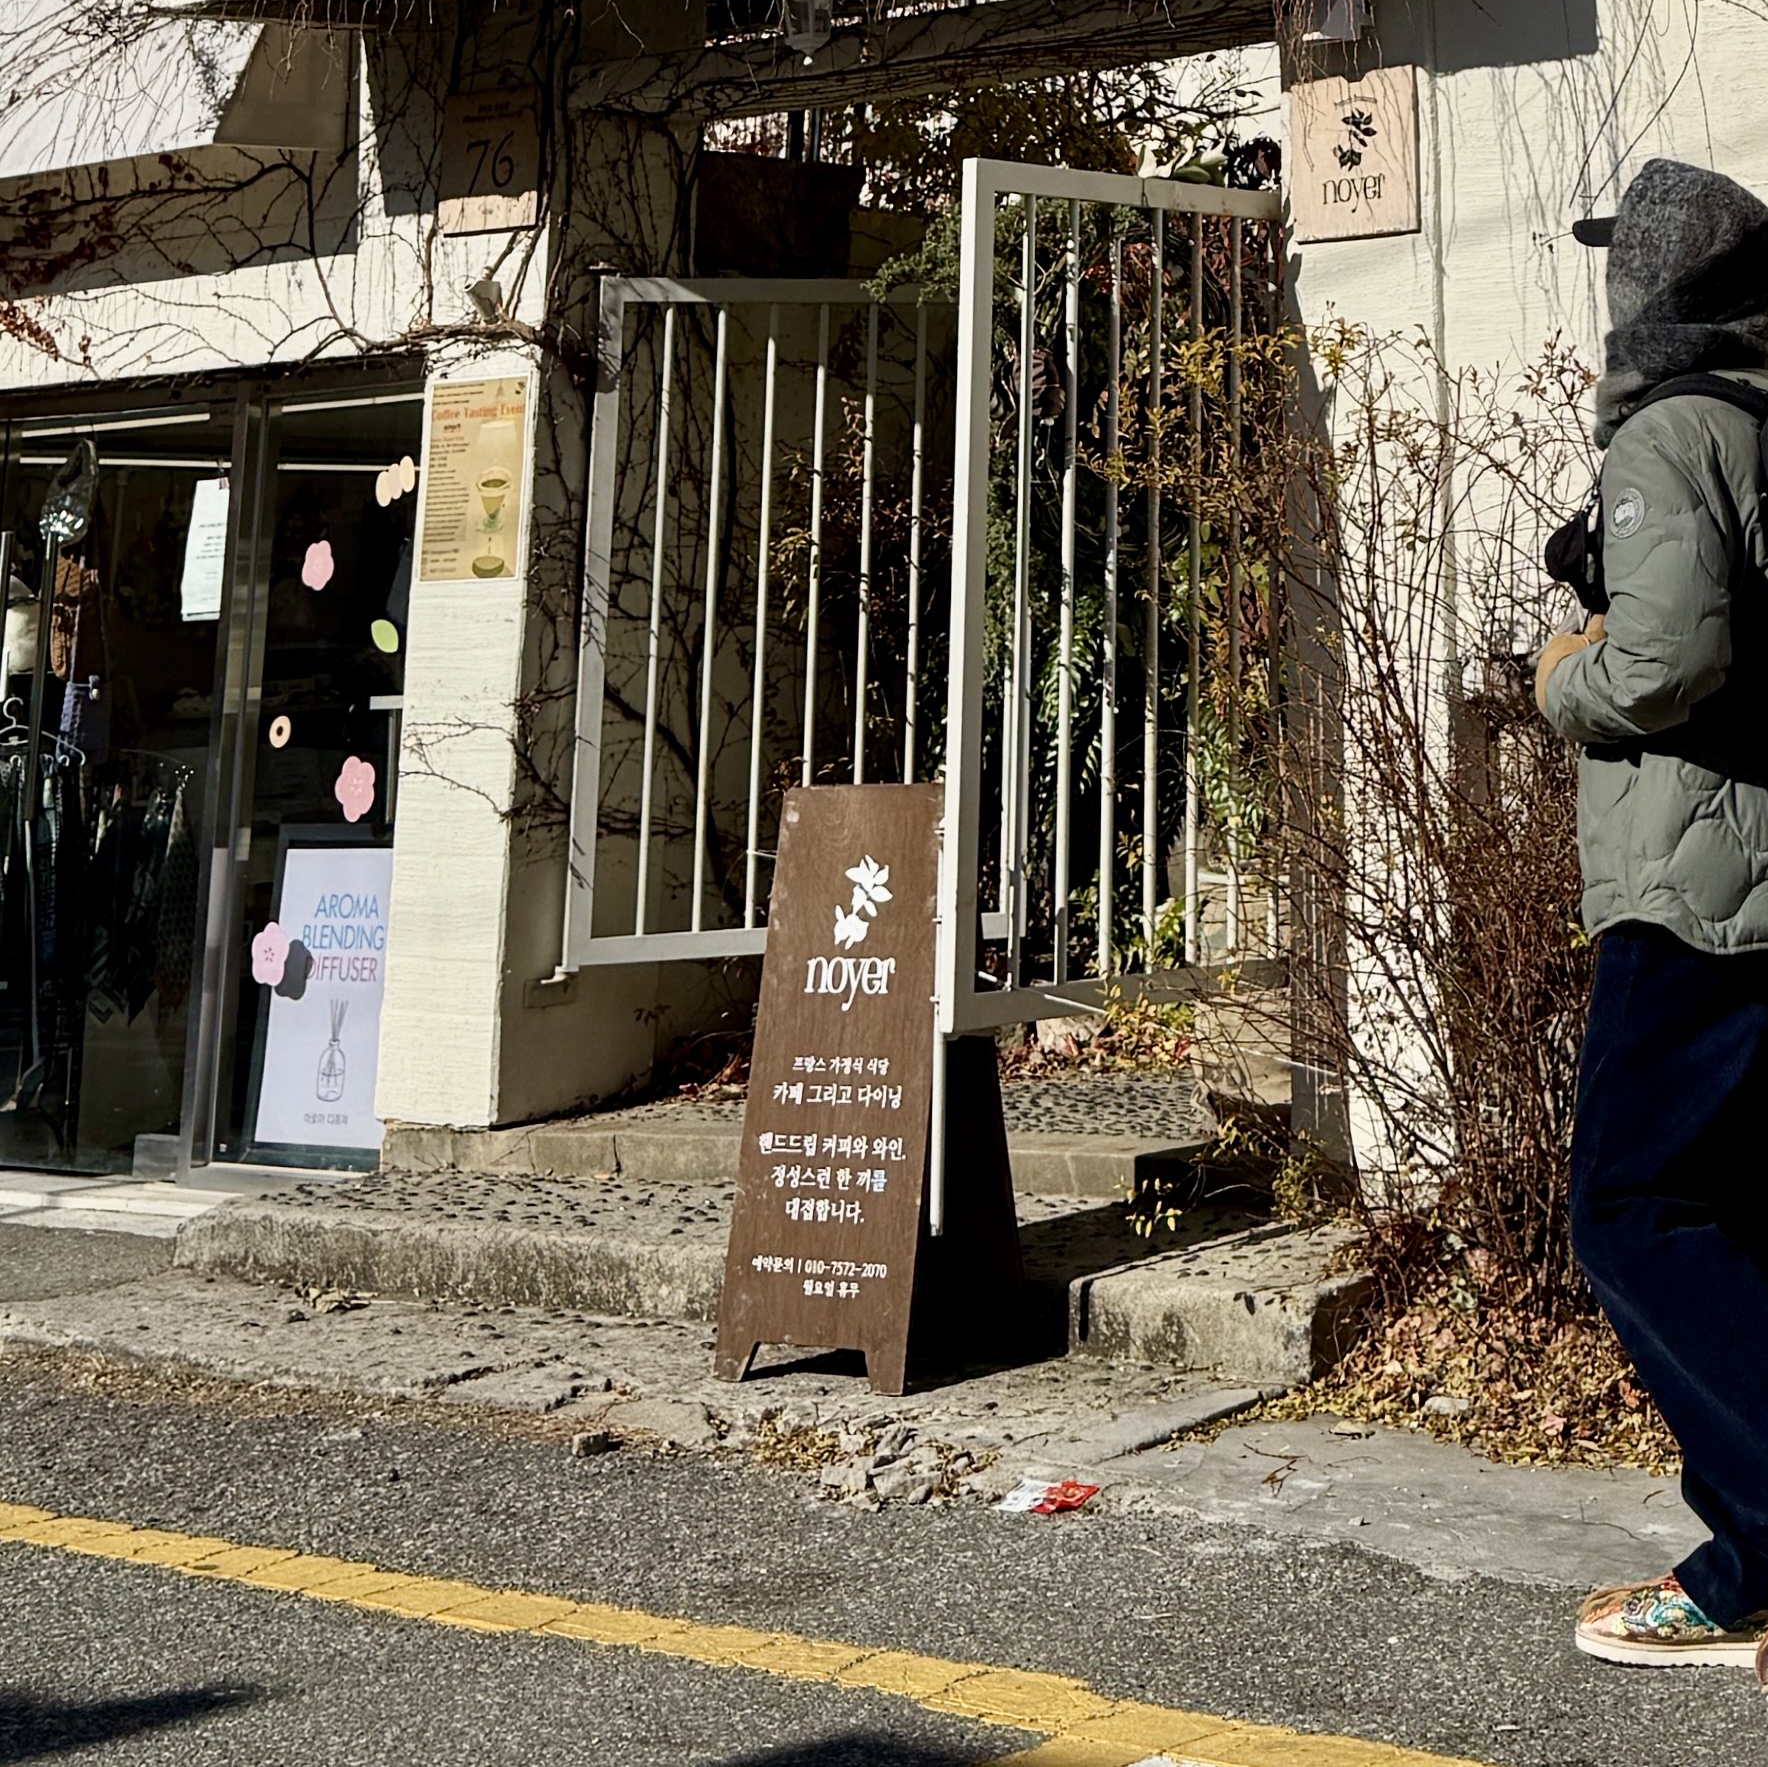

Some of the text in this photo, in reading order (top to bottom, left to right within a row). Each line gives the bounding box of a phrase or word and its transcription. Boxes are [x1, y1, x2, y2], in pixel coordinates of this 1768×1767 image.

[466, 130, 515, 195] 76
[1322, 173, 1386, 213] noyer
[464, 406, 497, 419] Tasting
[314, 893, 379, 919] AROMA
[303, 924, 385, 951] BLENDING
[305, 954, 378, 982] DIFFUSER
[804, 956, 896, 1011] noyer
[792, 1055, 890, 1076] 프랑스 가정식 식당
[773, 1081, 903, 1109] 카페 그리고 다이닝
[822, 1134, 868, 1160] 커피와
[872, 1137, 907, 1161] 와인.
[771, 1164, 888, 1193] 정성스런 한 끼를
[785, 1197, 865, 1225] 대접합니다.
[752, 1255, 794, 1274] 예약문의
[804, 1259, 888, 1279] 010-7572-2070
[803, 1279, 860, 1299] 월요일 휴무
